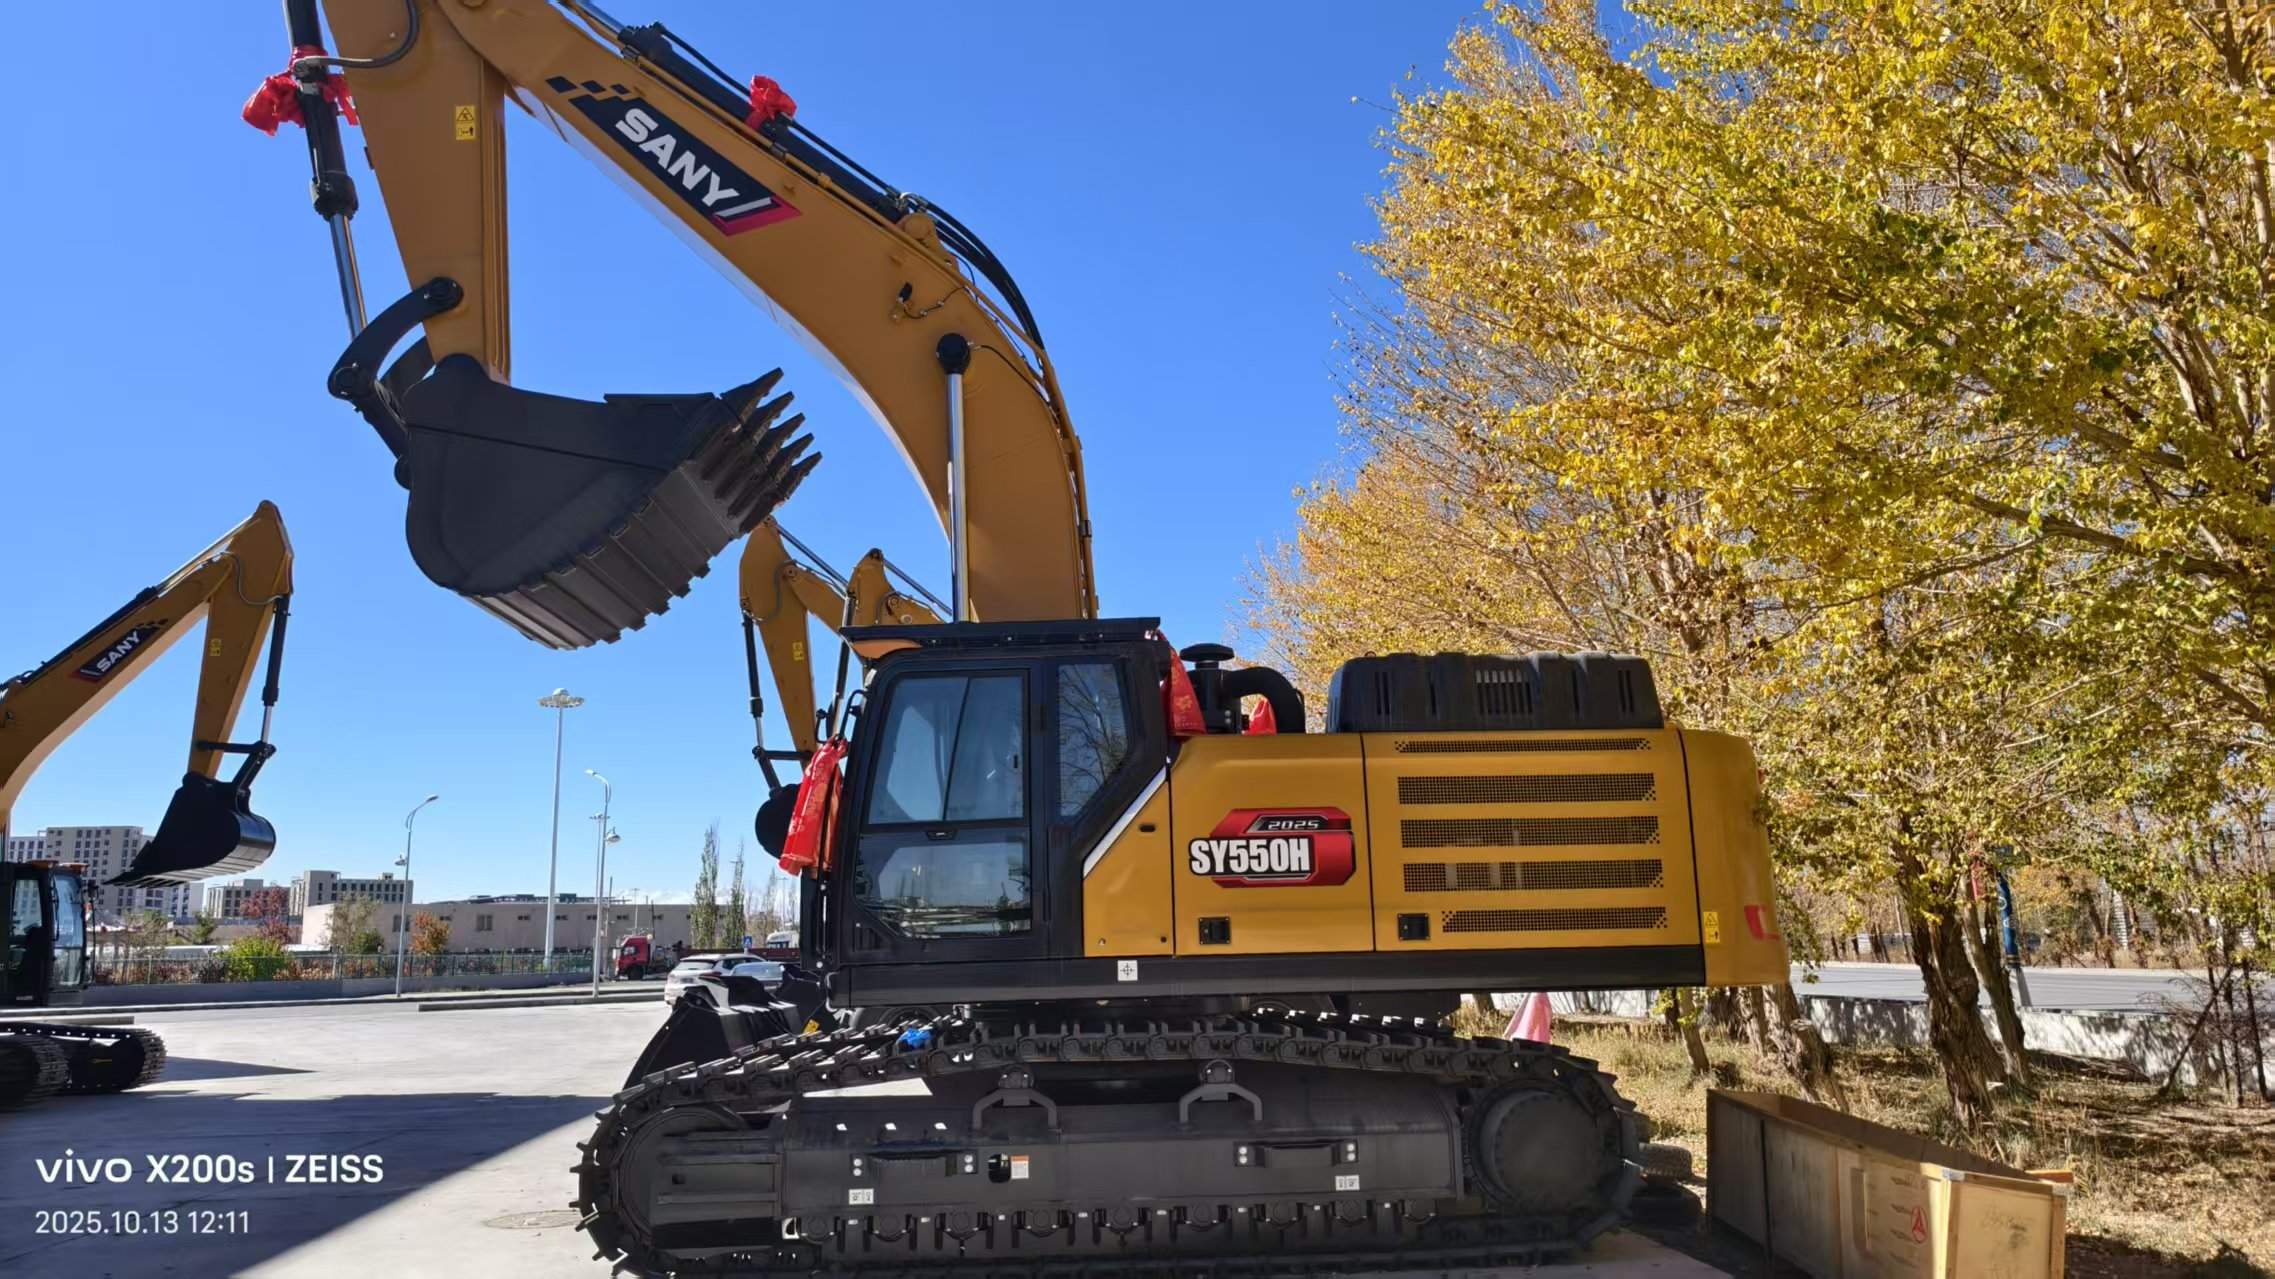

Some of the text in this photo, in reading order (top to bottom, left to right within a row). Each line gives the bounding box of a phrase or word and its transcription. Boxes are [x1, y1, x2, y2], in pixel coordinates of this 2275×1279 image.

[615, 107, 739, 208] SANY
[96, 630, 141, 672] SANY
[1267, 820, 1320, 830] 2025
[1190, 837, 1310, 874] SY550H
